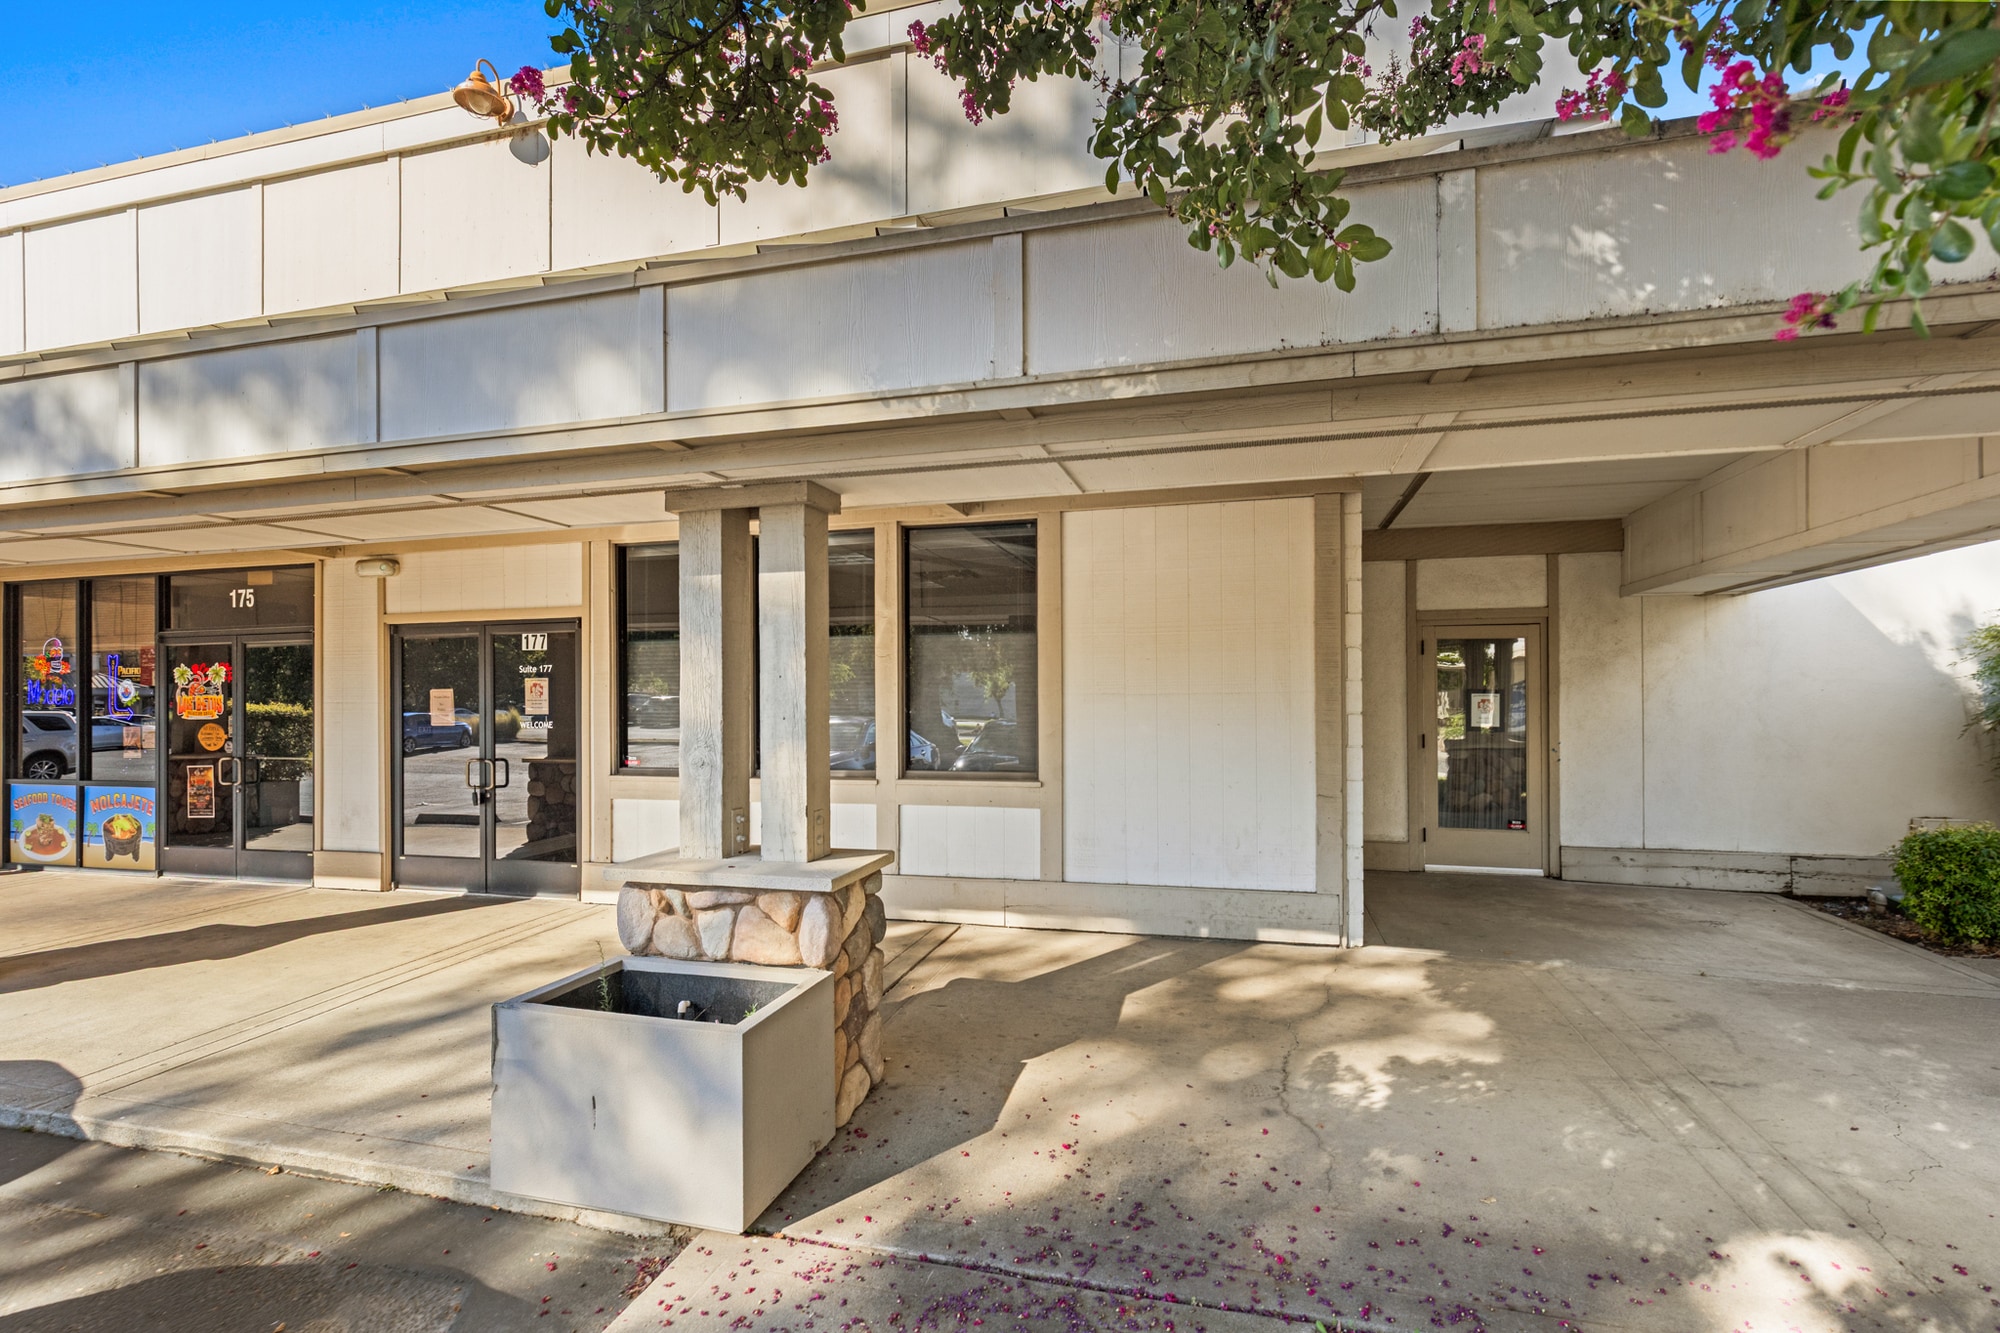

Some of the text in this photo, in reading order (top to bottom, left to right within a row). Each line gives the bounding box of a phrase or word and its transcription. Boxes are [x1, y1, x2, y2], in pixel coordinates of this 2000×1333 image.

[229, 588, 255, 608] 175
[524, 634, 546, 650] 177
[518, 664, 553, 674] Suite 177
[27, 678, 75, 706] Modelo
[177, 694, 193, 714] LOS
[519, 720, 554, 729] WELCOME
[13, 792, 49, 811] SEAFOOD
[90, 793, 155, 816] MOLCAJETE
